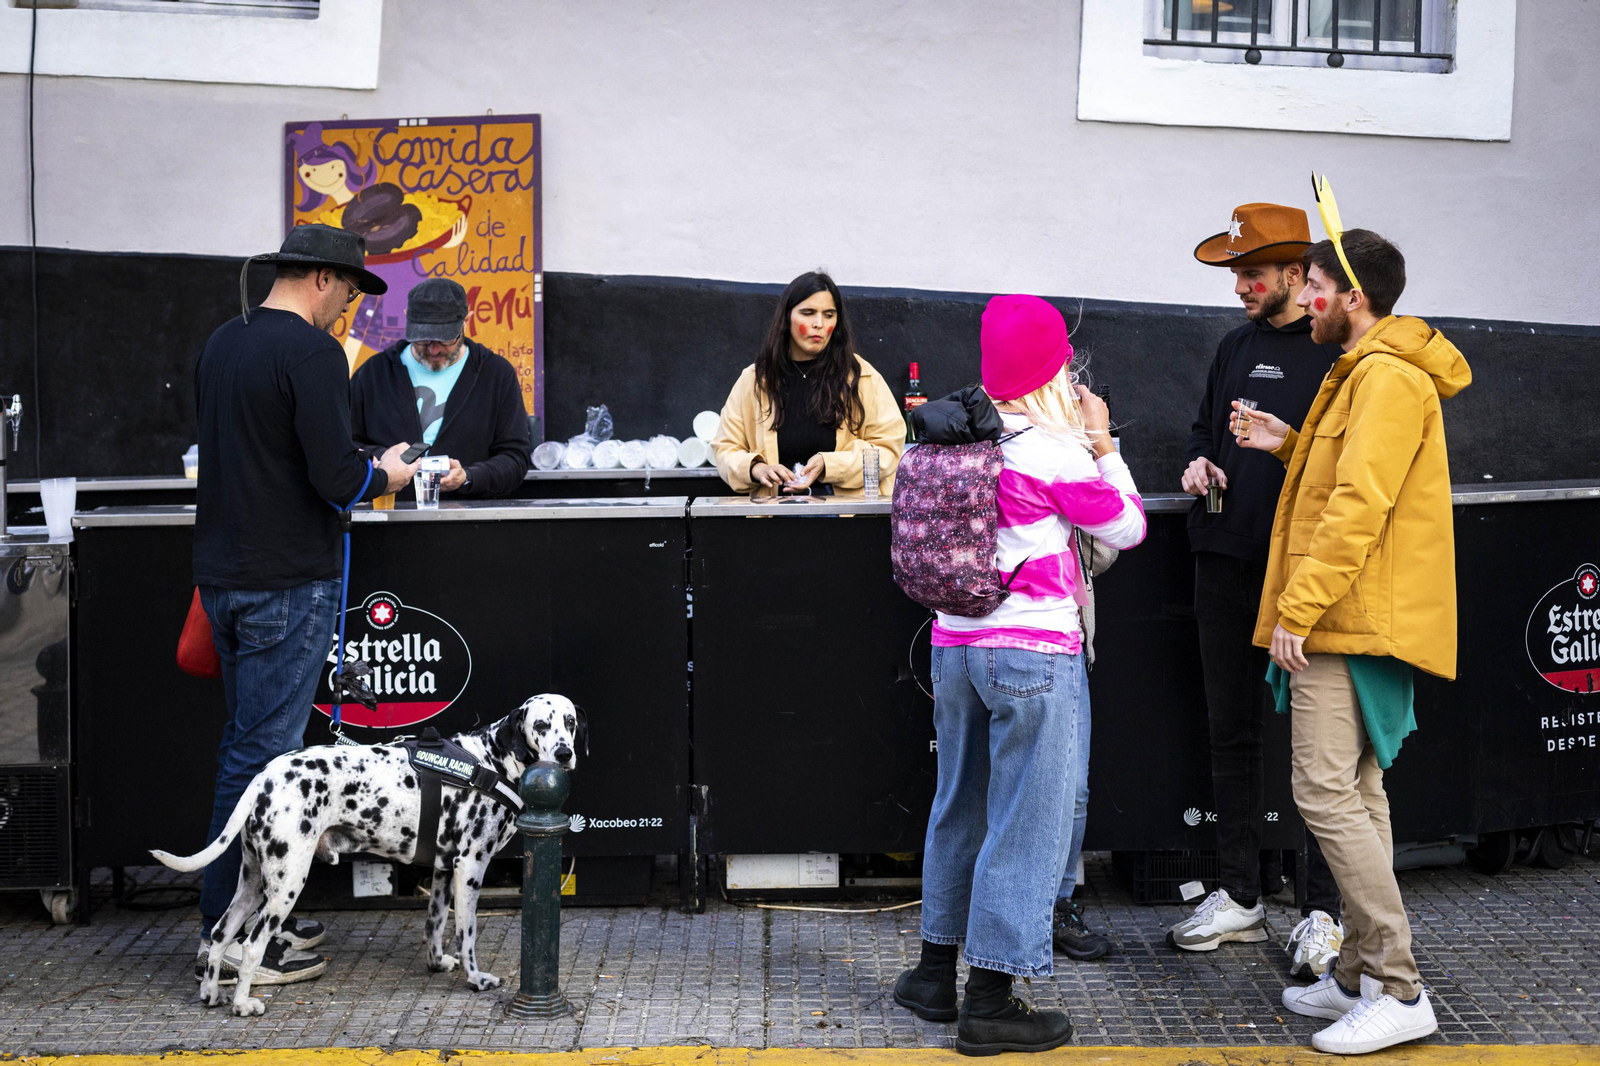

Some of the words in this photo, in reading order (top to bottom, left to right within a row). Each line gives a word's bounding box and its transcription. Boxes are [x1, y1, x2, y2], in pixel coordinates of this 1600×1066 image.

[476, 209, 506, 238] de
[1551, 632, 1600, 664] Gali
[589, 817, 637, 828] Xacobeo
